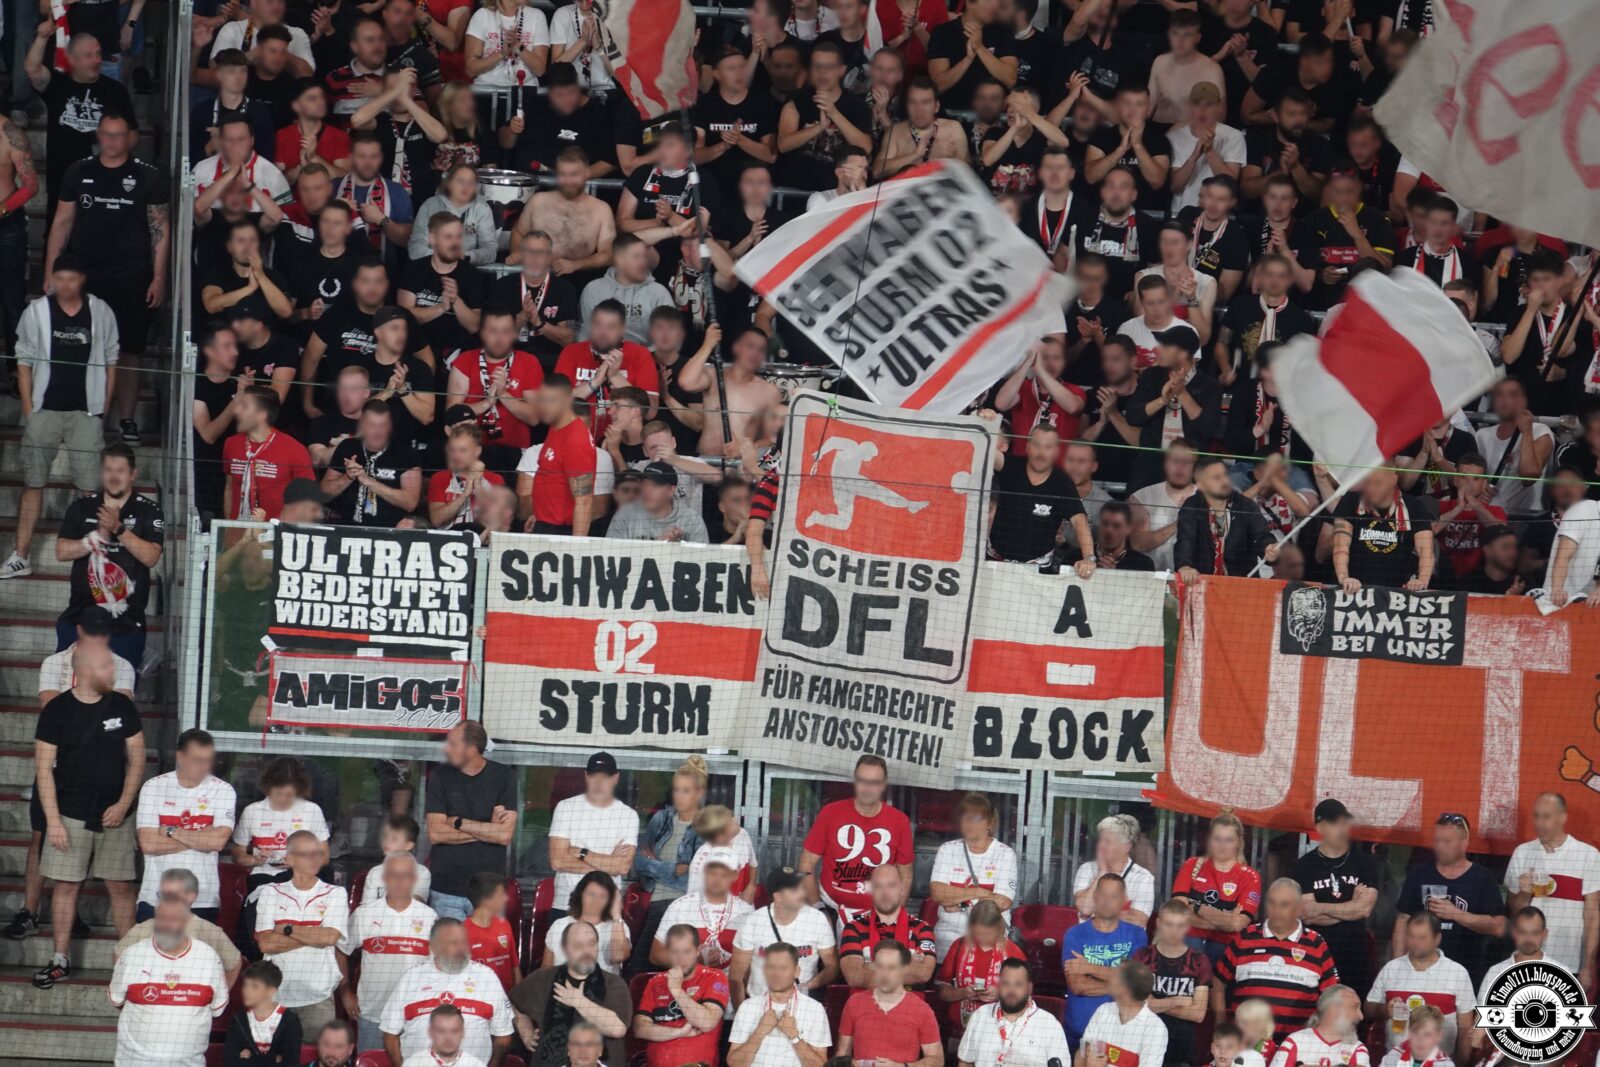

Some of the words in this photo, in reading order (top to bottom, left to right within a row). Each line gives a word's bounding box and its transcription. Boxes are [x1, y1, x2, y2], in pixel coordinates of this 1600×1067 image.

[777, 178, 969, 327] SCHWABEN
[823, 251, 943, 360] STURM
[930, 210, 997, 269] 02
[878, 269, 1008, 389] ULTRAS
[281, 532, 468, 582] ULTRAS
[500, 549, 755, 616] SCHWABEN
[787, 538, 960, 598] SCHEISS
[277, 570, 467, 611] BEDEUTET
[1053, 585, 1093, 638] A
[1334, 588, 1375, 608] DU
[1389, 591, 1457, 615] BIST
[275, 600, 468, 636] WIDERSTAND
[782, 575, 954, 668] DFL
[1333, 610, 1453, 640] IMMER
[594, 621, 658, 674] 02
[1331, 635, 1376, 653] BEI
[1387, 639, 1455, 660] UNS!
[388, 708, 461, 729] 2010
[540, 679, 711, 735] STURM
[761, 664, 804, 700] FÜR
[807, 675, 956, 731] FANGERECHTE
[763, 707, 944, 769] ANSTOSSZEITEN!
[973, 706, 1154, 764] BLOCK
[835, 824, 892, 868] 93
[1083, 943, 1109, 954] SINCE
[160, 989, 201, 997] Mercedes-Benz
